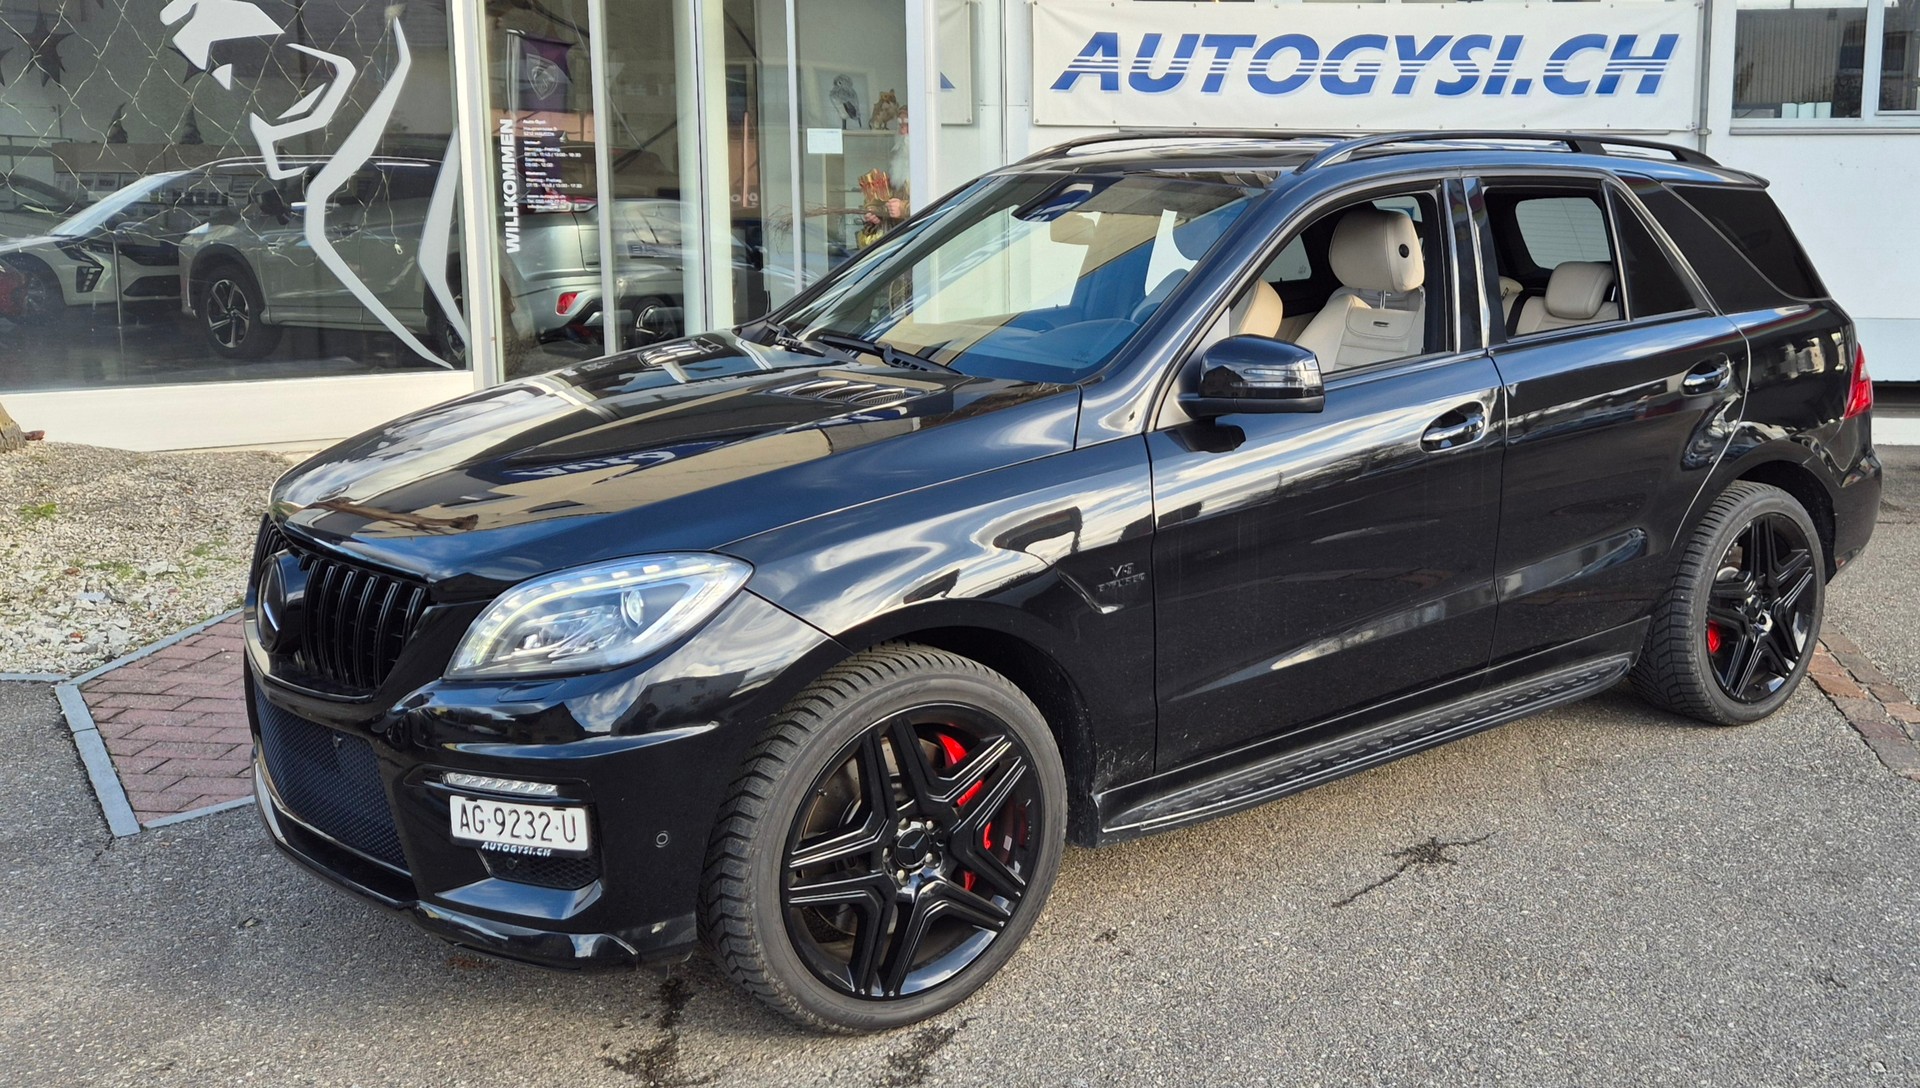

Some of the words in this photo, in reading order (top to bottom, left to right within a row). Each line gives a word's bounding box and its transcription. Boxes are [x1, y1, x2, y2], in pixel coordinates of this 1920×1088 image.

[1049, 32, 1683, 96] AUTOGYSI.CH
[500, 119, 520, 253] WILLKOMMEN
[481, 841, 552, 857] AUTOGYSI.CH
